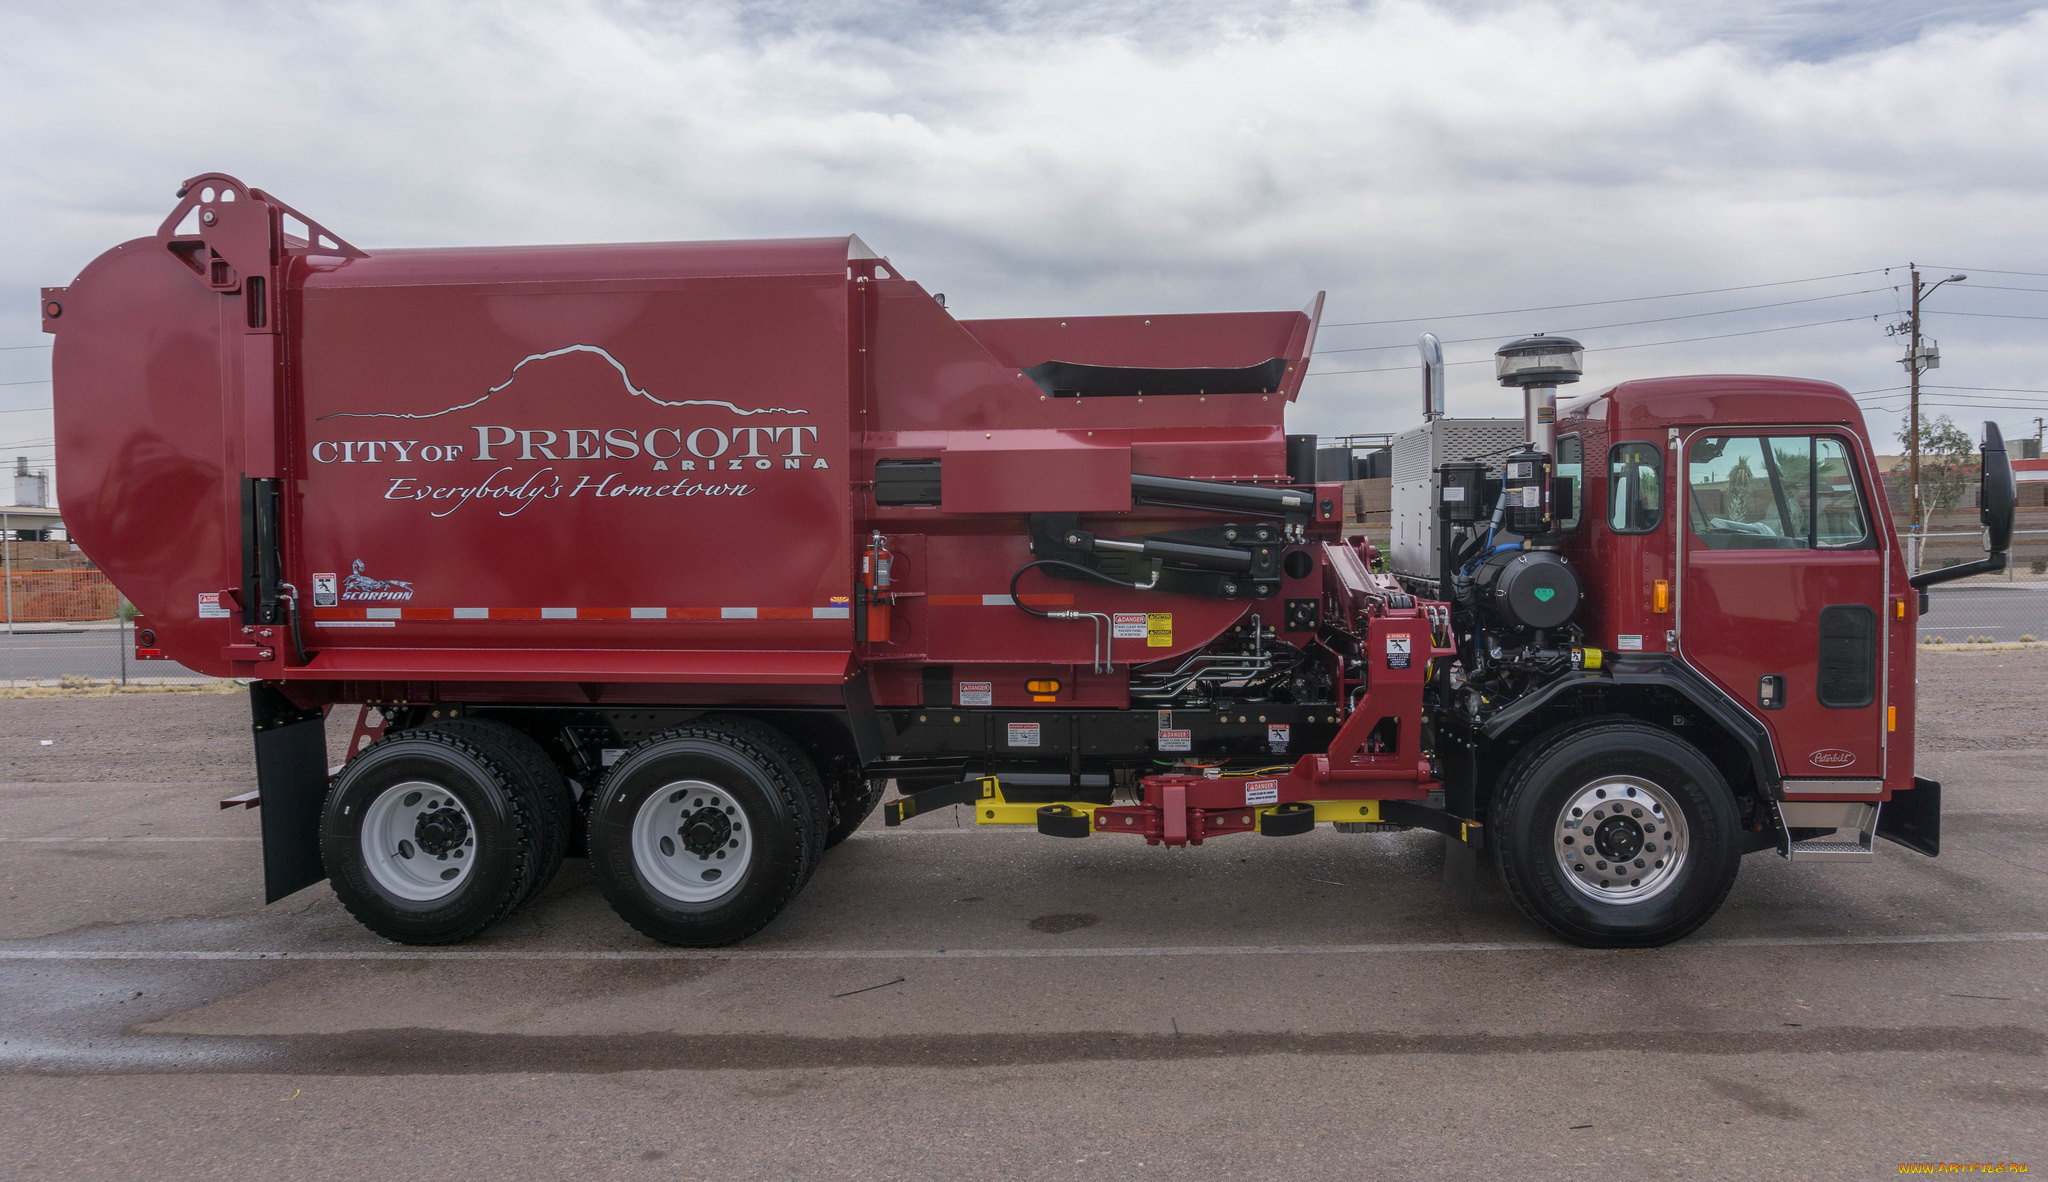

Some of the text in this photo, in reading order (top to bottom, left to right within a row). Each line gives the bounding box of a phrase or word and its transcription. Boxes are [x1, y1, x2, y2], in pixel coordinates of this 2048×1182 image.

[312, 425, 818, 464] CITY OF PRESCOTT
[652, 458, 829, 471] ARIZONA
[384, 467, 756, 518] Everybody's Hometown
[341, 591, 413, 601] SCORPION
[1814, 752, 1852, 763] Peterbilt
[1254, 782, 1274, 790] DANGER
